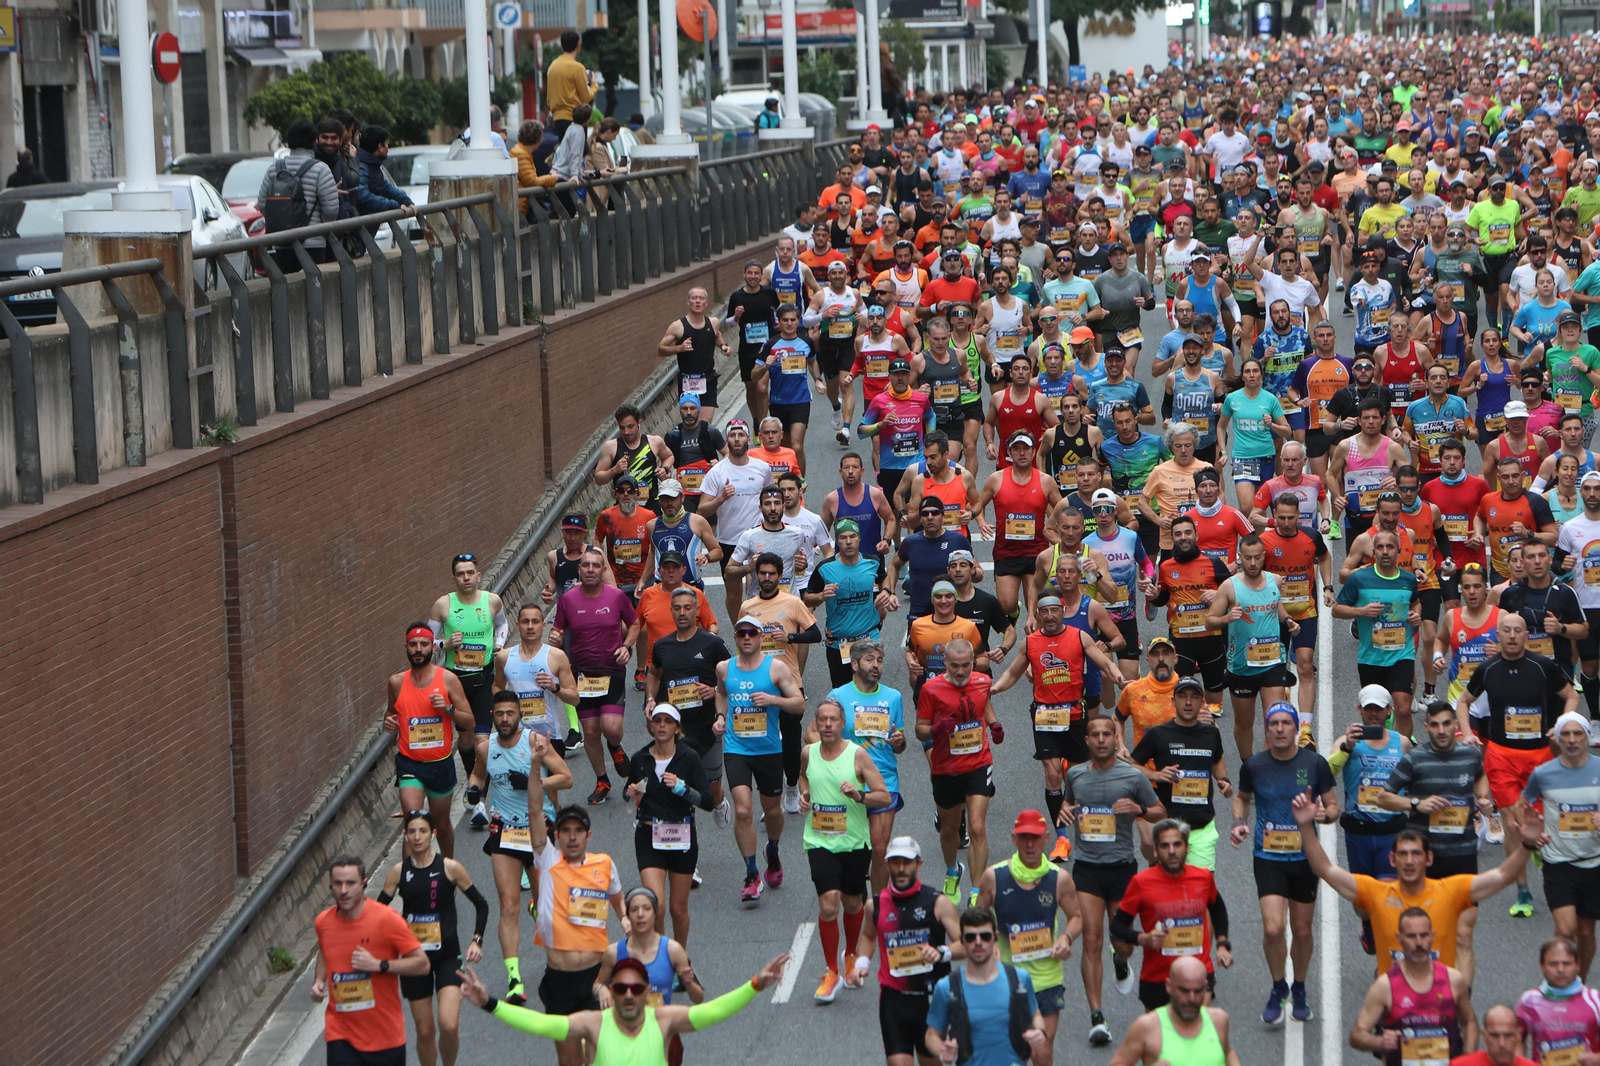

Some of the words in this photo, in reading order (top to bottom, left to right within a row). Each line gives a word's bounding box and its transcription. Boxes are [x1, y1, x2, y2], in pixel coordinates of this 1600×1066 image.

[1458, 646, 1486, 655] PALACIE
[730, 693, 752, 701] TOD
[960, 722, 979, 730] ZURICH
[583, 889, 606, 899] ZURICH
[1022, 922, 1045, 932] ZURICH
[900, 936, 923, 946] ZURICH
